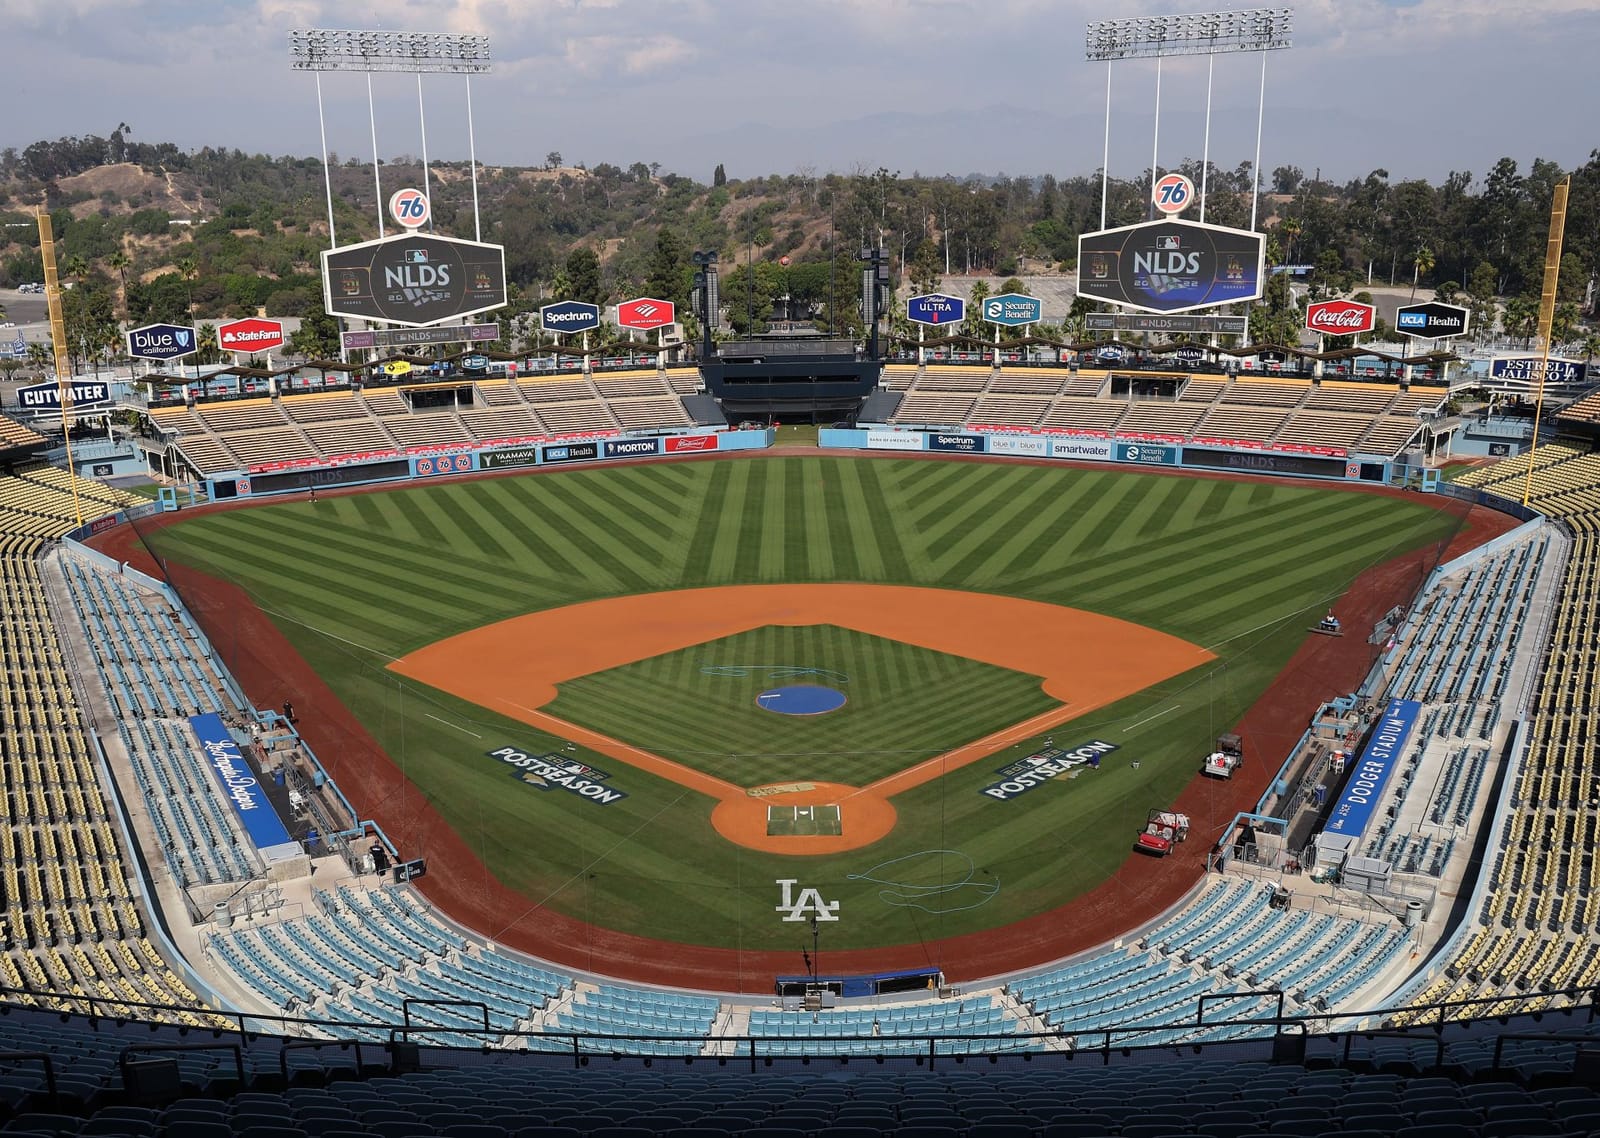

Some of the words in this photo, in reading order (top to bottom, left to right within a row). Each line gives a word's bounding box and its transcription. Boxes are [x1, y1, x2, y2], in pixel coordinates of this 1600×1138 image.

[1161, 182, 1186, 203] 76
[400, 197, 424, 217] 76
[1134, 252, 1200, 274] NLDS
[385, 264, 450, 288] NLDS
[920, 303, 952, 311] ULTRA
[1005, 302, 1036, 310] Security
[546, 311, 593, 324] Spectrum
[1005, 310, 1031, 318] Benefit
[1312, 308, 1366, 327] Coca-Cola
[1148, 319, 1172, 328] NLDS
[1401, 316, 1424, 325] UCLA
[1428, 316, 1460, 326] Health
[135, 332, 173, 347] blue
[407, 332, 431, 341] NLDS
[143, 346, 178, 354] california
[1498, 369, 1560, 381] JALISCO
[24, 386, 103, 405] CUTWATER
[938, 436, 974, 444] Spectrum
[570, 447, 593, 456] Health
[617, 443, 654, 453] MORTON
[1055, 444, 1108, 455] smartwater
[1141, 447, 1166, 456] Security
[421, 462, 430, 471] 76
[458, 458, 468, 466] 76
[1240, 455, 1275, 469] NLDS
[309, 471, 342, 483] NLDS
[1348, 761, 1385, 804] DODGER
[1371, 719, 1405, 758] STADIUM
[491, 747, 622, 803] POSTSEASON
[985, 741, 1115, 799] POSTSEASON
[775, 879, 840, 922] LA
